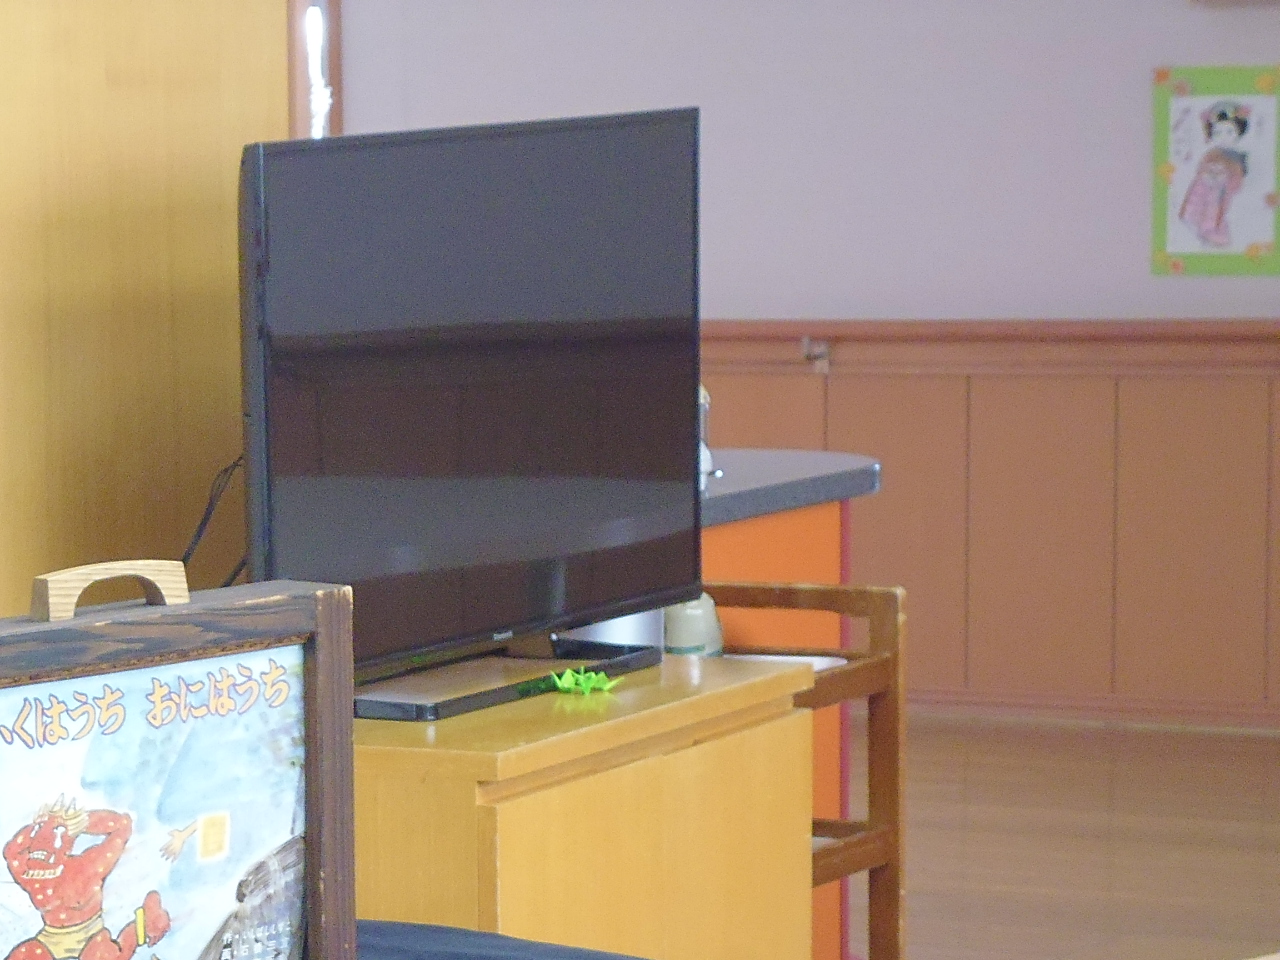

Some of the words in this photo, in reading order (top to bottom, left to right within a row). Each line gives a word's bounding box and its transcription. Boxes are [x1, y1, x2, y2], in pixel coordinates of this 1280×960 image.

[145, 658, 291, 729] おにはうち
